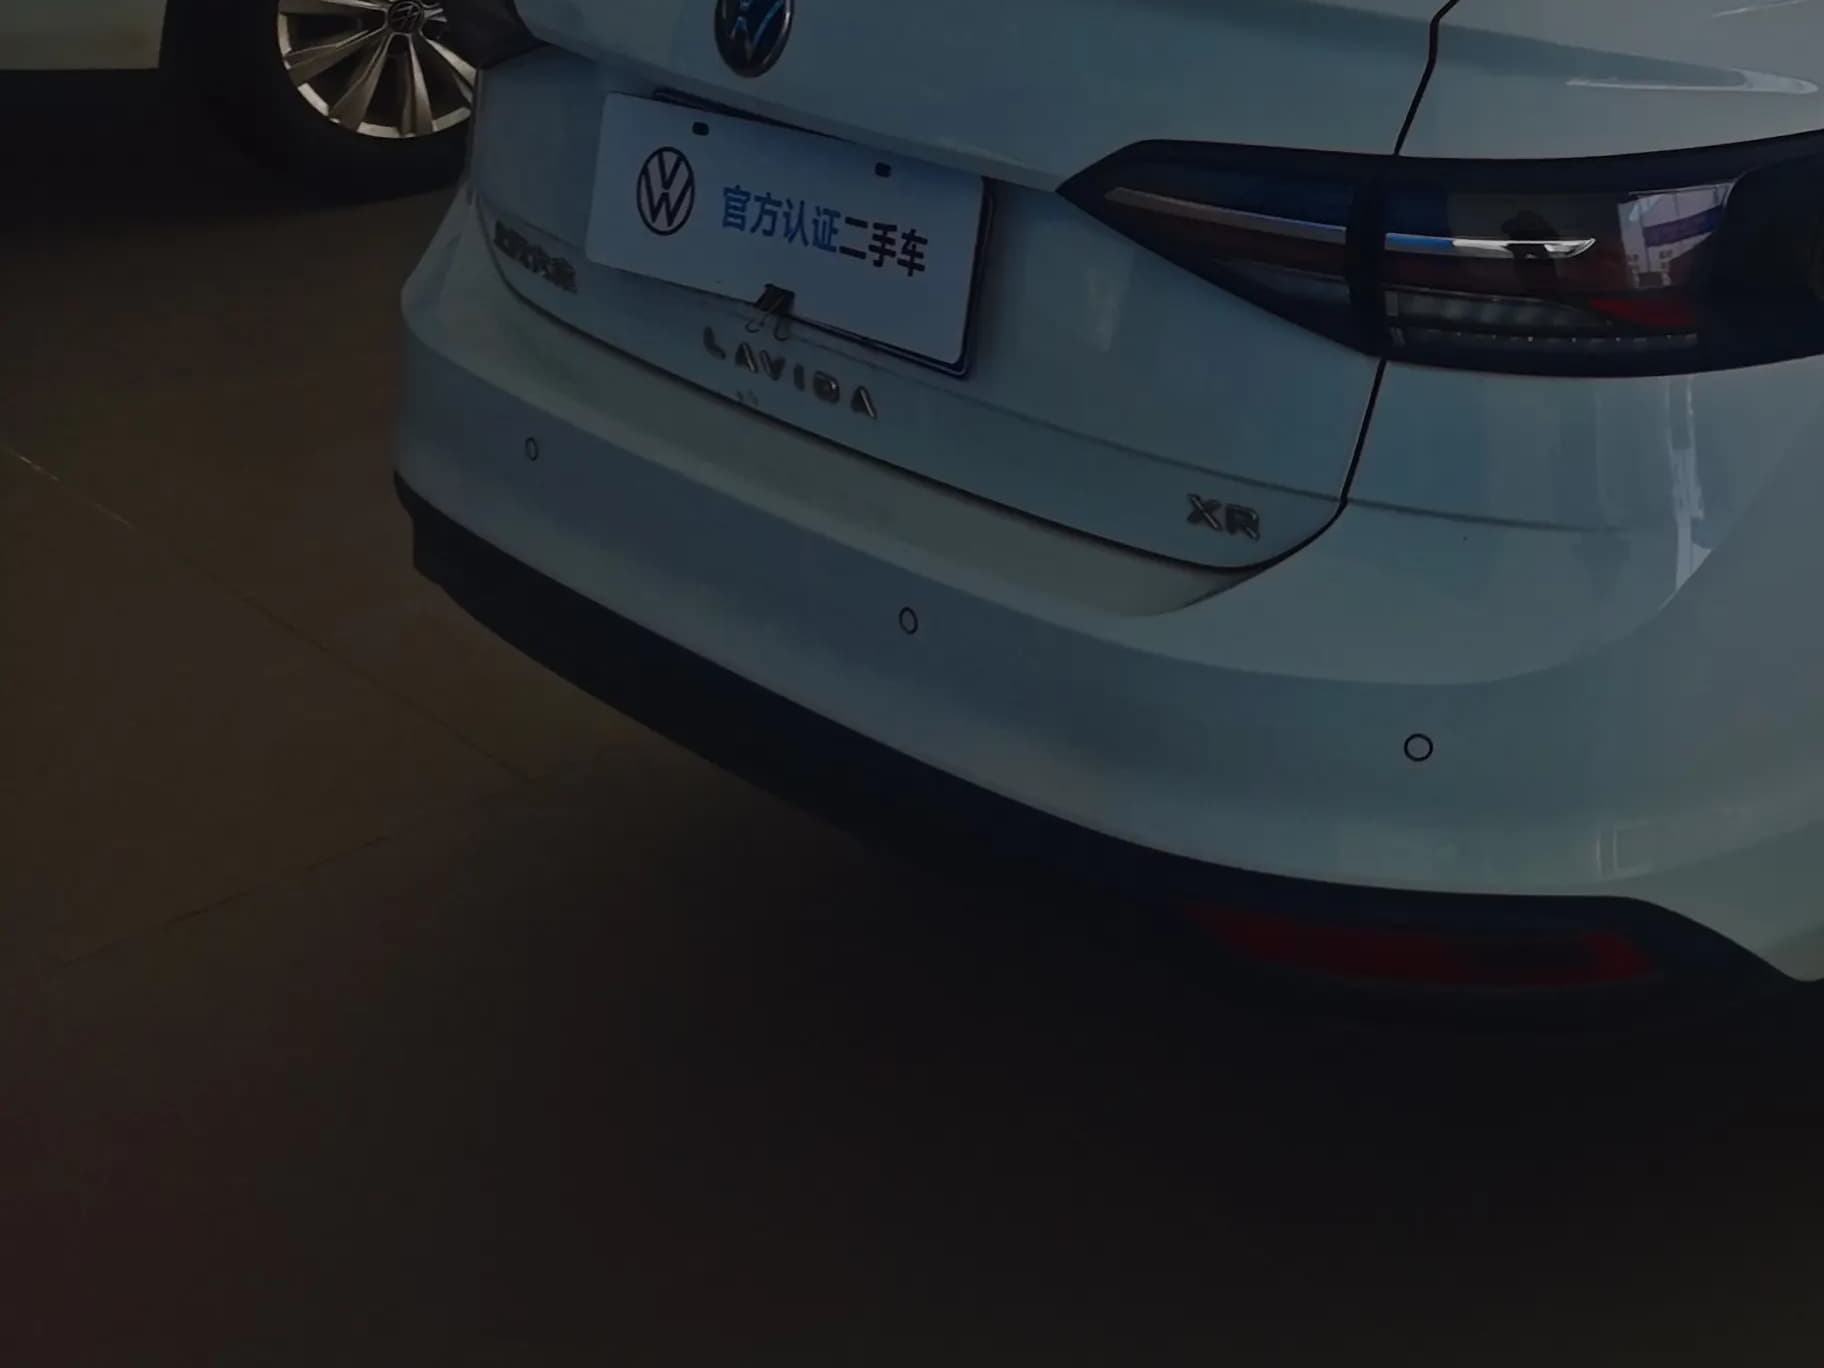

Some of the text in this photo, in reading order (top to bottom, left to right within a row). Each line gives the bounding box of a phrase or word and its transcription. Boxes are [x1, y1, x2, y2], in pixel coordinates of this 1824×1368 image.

[721, 184, 929, 278] 官方认证二手车
[702, 325, 878, 420] LAVIDA
[1185, 492, 1262, 543] XR
